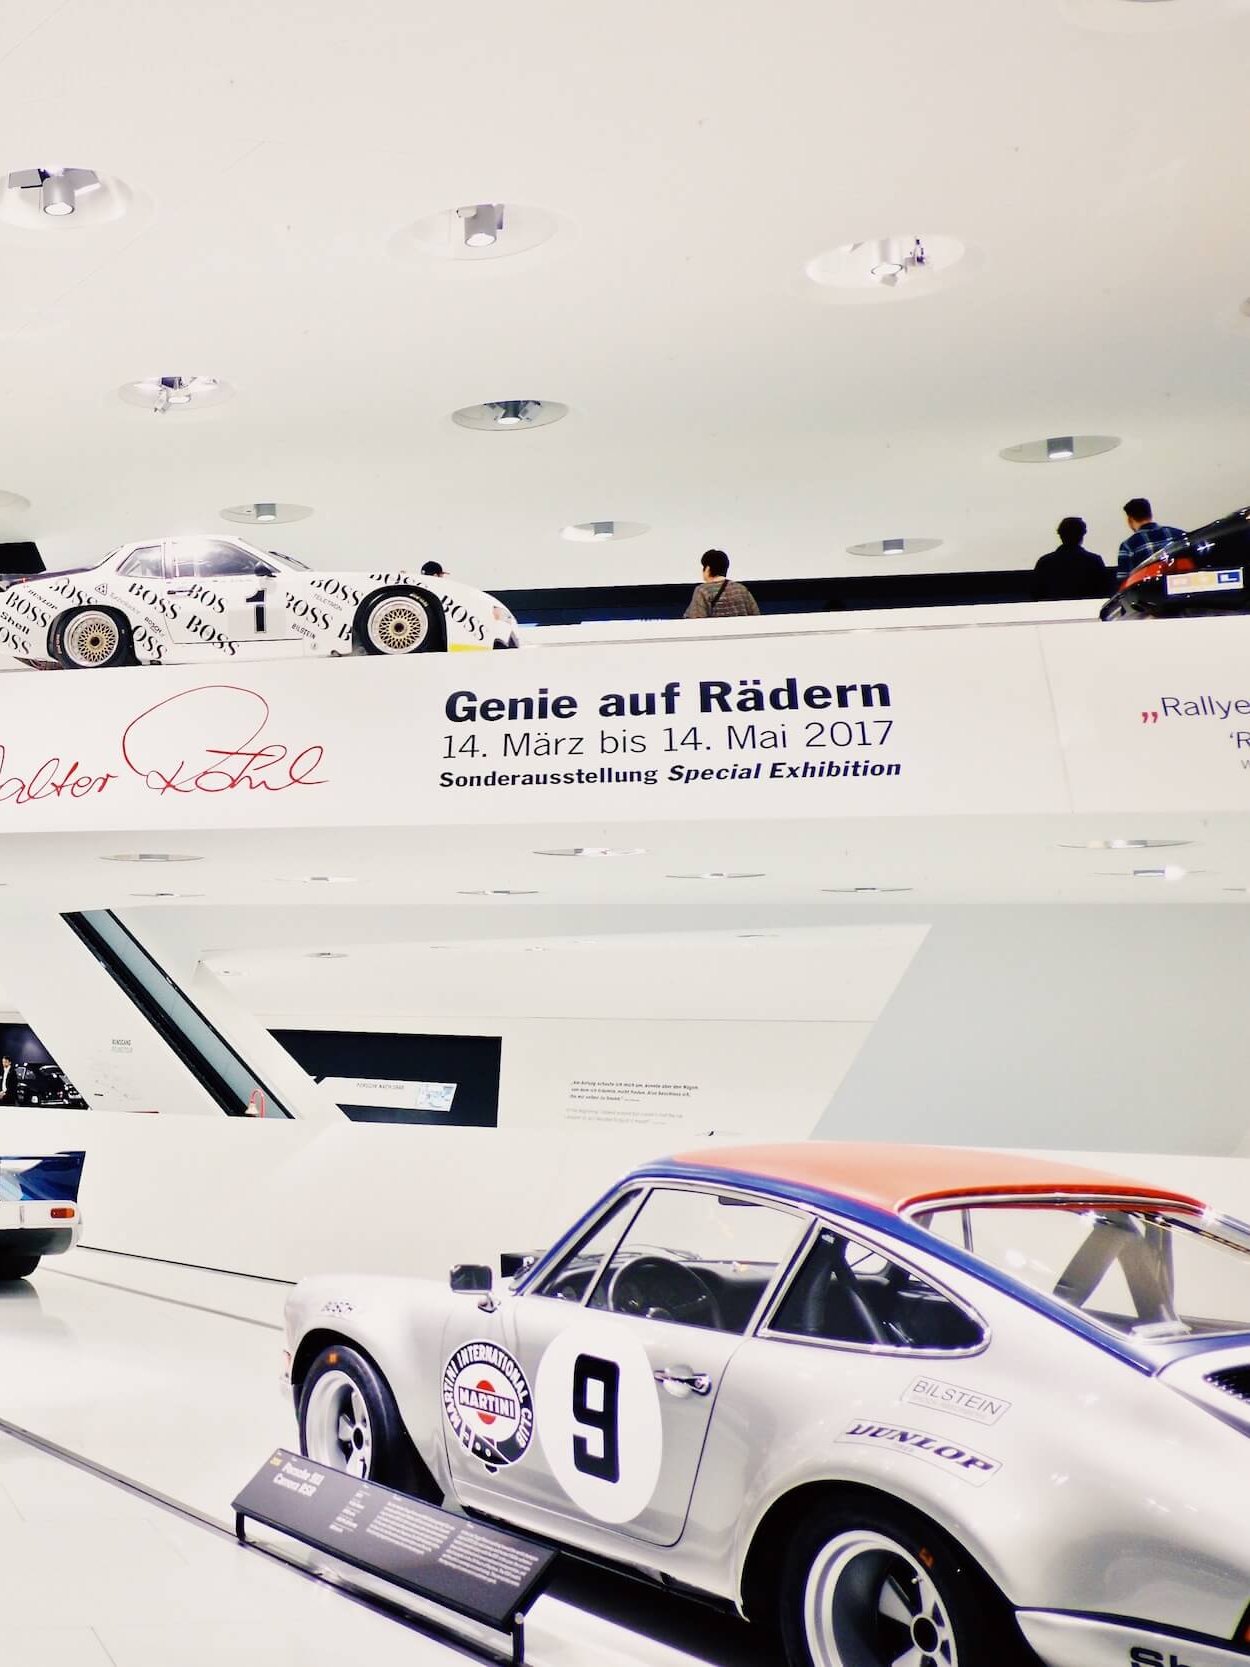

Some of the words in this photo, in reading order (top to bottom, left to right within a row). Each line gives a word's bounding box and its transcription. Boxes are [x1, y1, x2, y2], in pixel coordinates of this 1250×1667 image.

[5, 591, 51, 628] BOSS
[128, 583, 181, 619] BOSS
[187, 584, 225, 613] BOS
[245, 588, 267, 633] 1
[441, 595, 489, 640] BOSS
[0, 611, 30, 635] Shell
[132, 625, 168, 659] OSS
[186, 615, 240, 656] BOSS
[445, 687, 578, 723] Genie
[598, 682, 681, 718] auf
[699, 678, 892, 713] Rädern
[442, 734, 487, 759] 14.
[503, 732, 585, 757] März
[600, 729, 647, 754] bis
[663, 726, 712, 752] 14.
[727, 723, 787, 750] Mai
[805, 720, 894, 748] 2017
[439, 767, 659, 788] Sonderausstellung
[668, 763, 762, 784] Special
[769, 759, 902, 780] Exhibition
[455, 1343, 529, 1404] INTERNATIONAL
[515, 1406, 533, 1449] CLUB
[459, 1387, 516, 1418] MARTINI
[912, 1379, 1002, 1415] BILSTEIN
[572, 1352, 621, 1485] 9
[846, 1424, 995, 1471] DUNLOP
